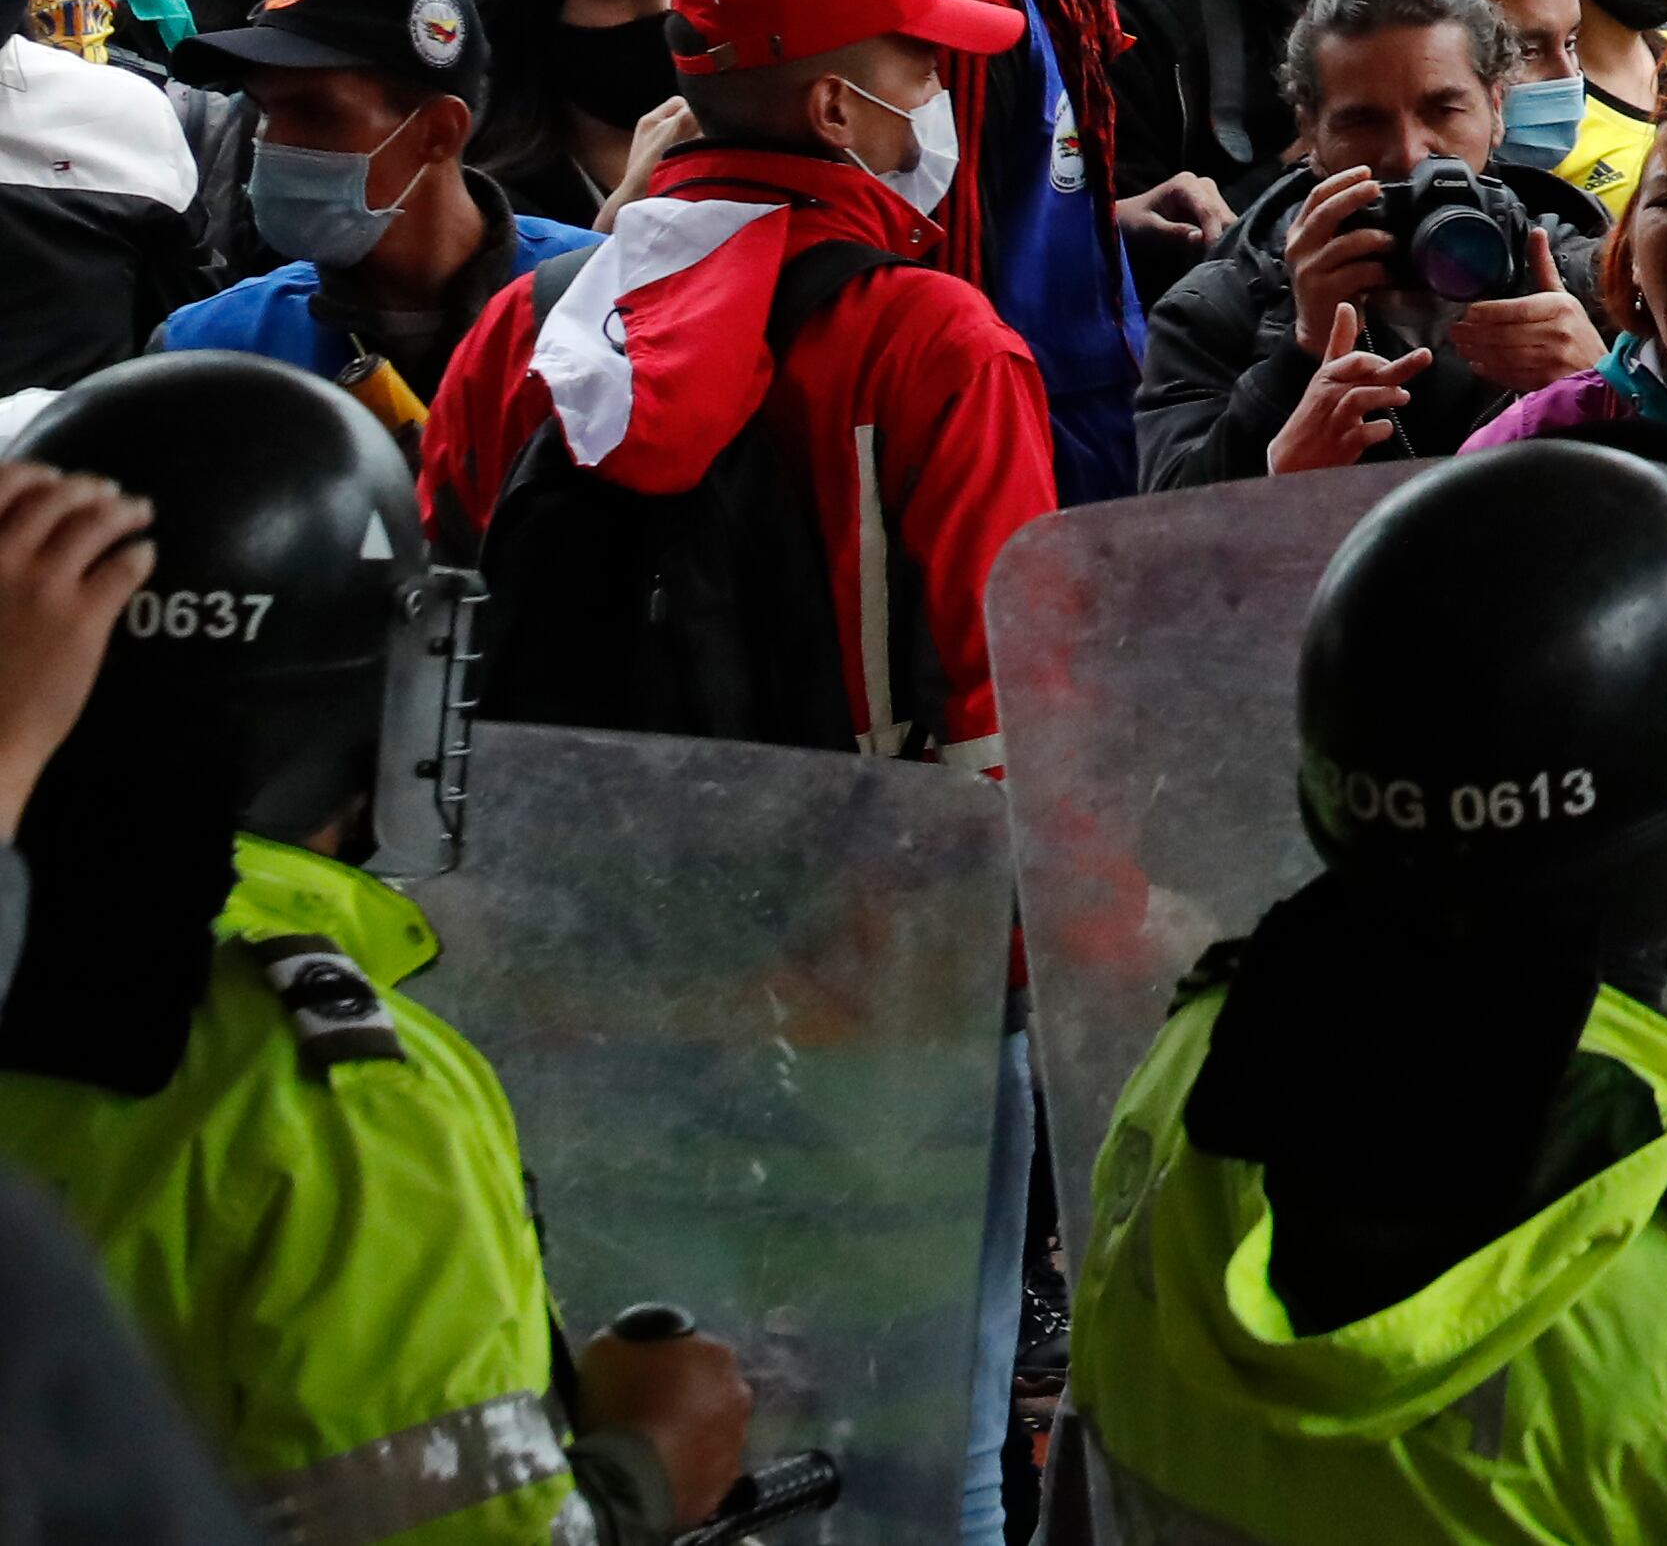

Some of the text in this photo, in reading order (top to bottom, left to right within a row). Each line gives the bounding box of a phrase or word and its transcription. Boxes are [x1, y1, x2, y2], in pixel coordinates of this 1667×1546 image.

[1433, 178, 1469, 187] Canon
[127, 590, 276, 642] 0637
[1449, 767, 1598, 832] 0613
